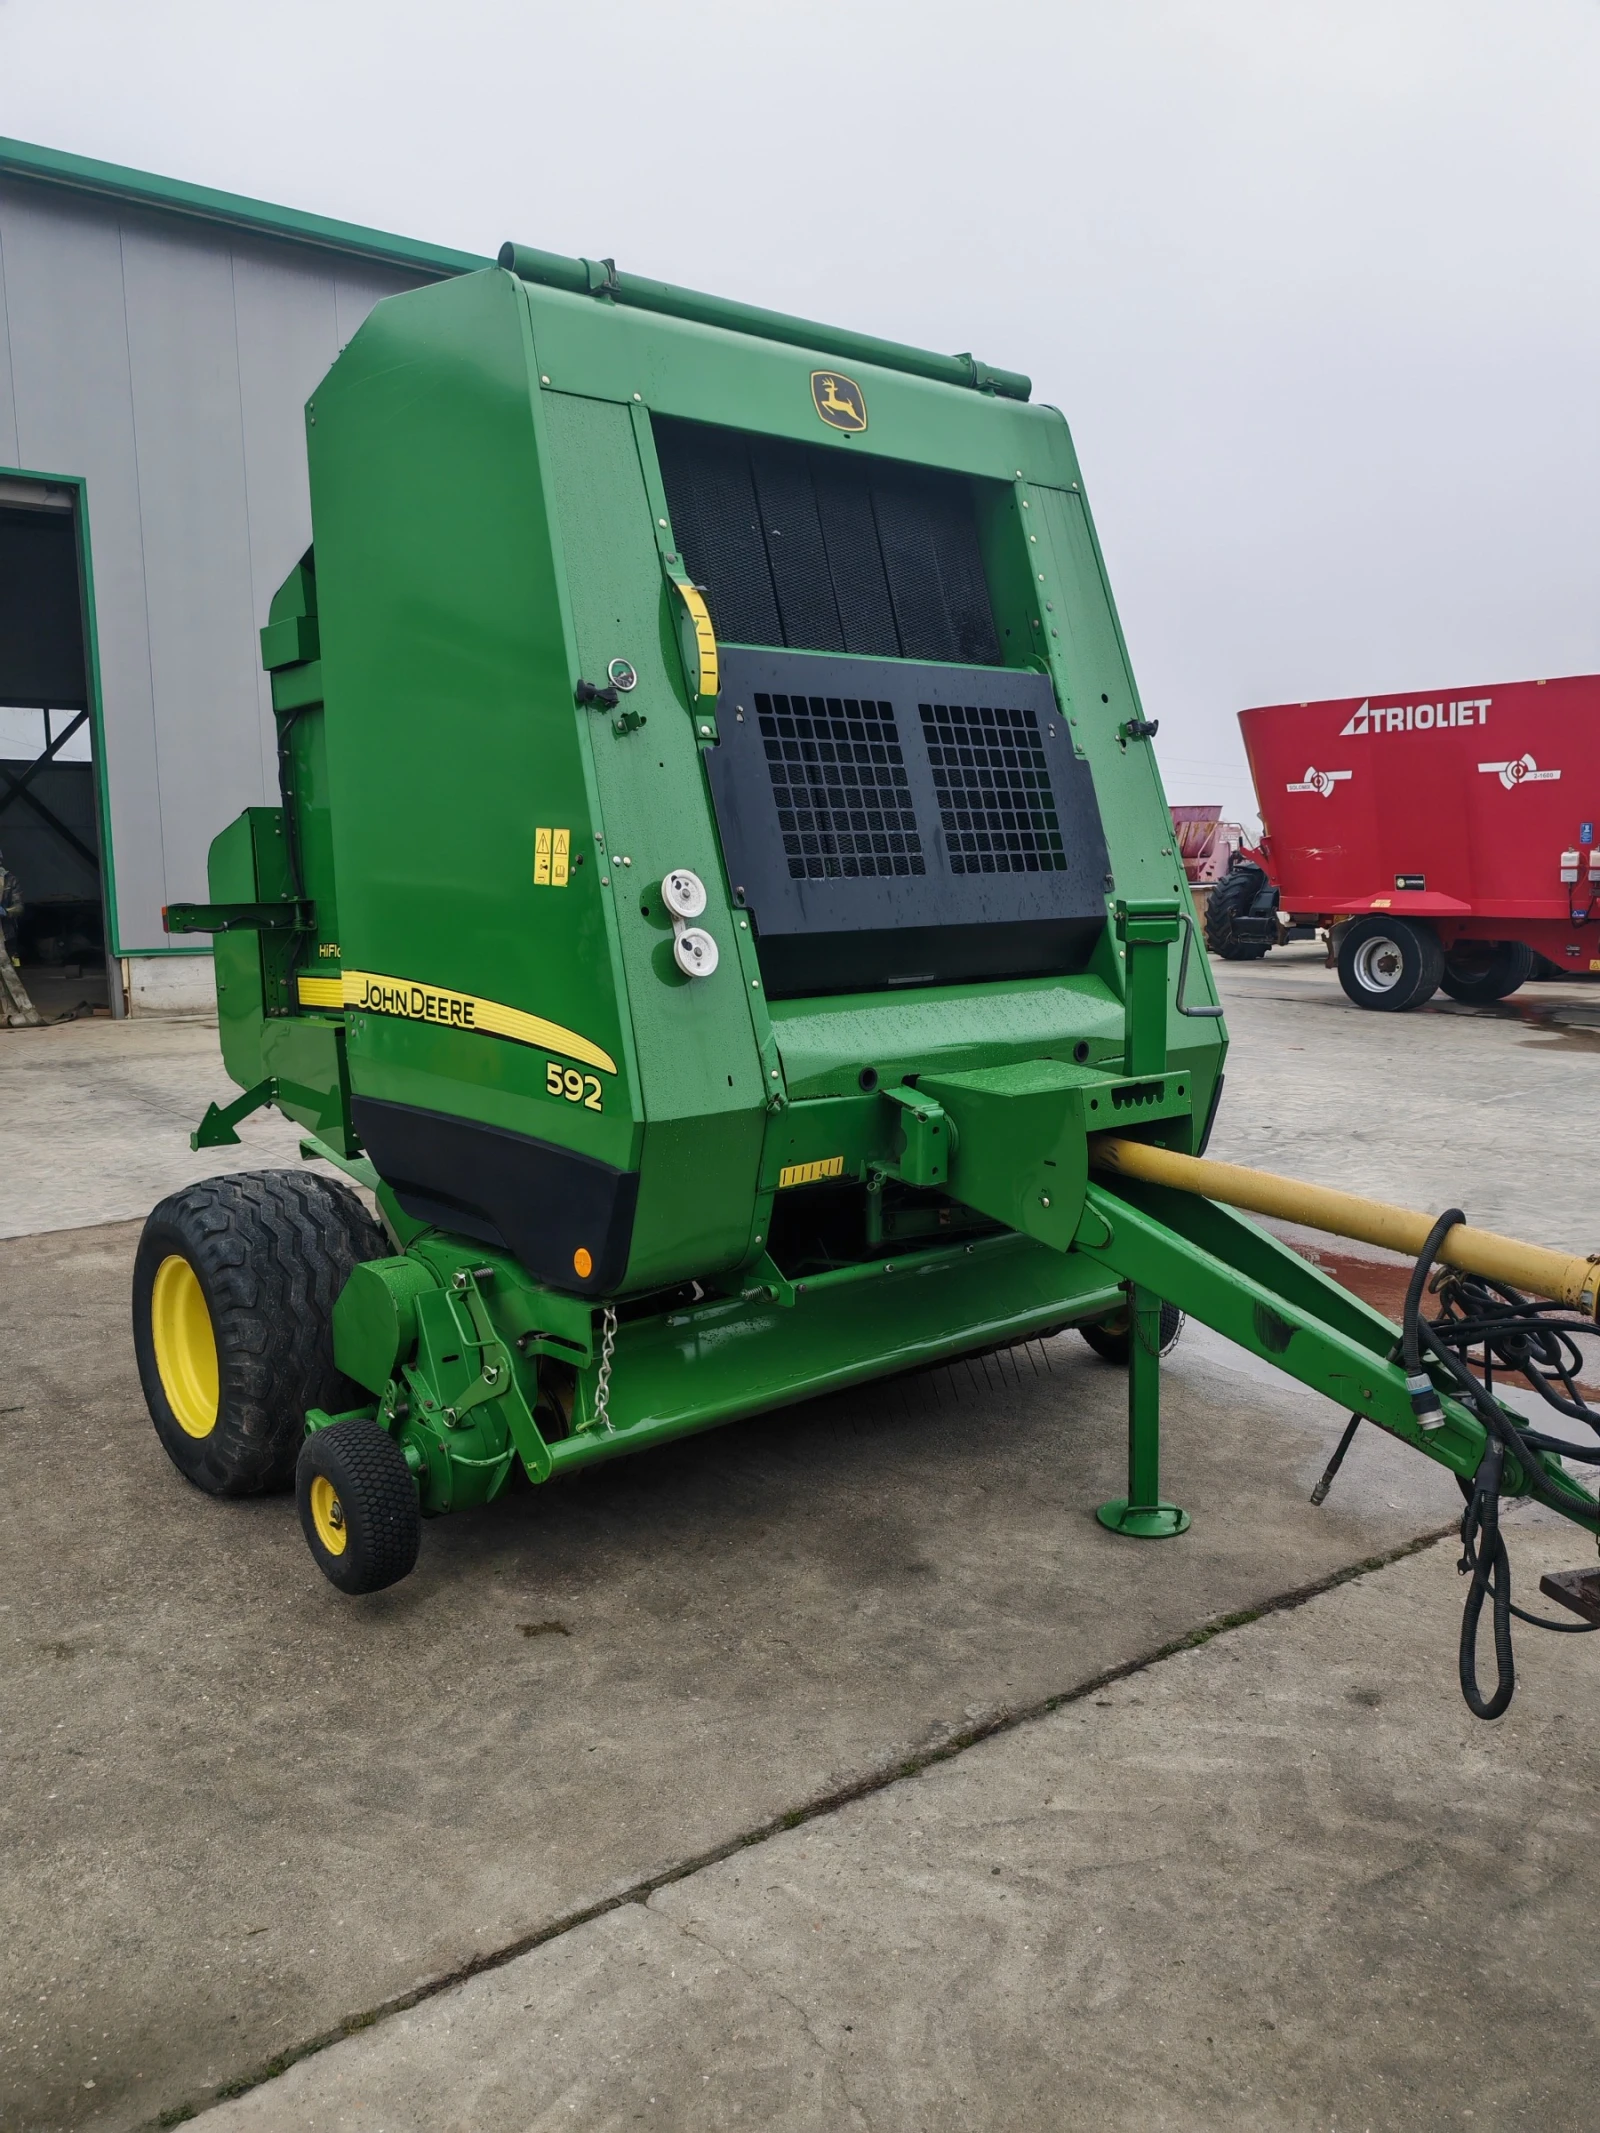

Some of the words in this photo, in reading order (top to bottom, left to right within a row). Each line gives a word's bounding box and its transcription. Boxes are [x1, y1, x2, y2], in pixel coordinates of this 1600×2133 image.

[1370, 699, 1492, 733] TRIOLIET
[359, 979, 409, 1014] JOHN
[411, 987, 475, 1027] DEERE
[546, 1062, 603, 1112] 592
